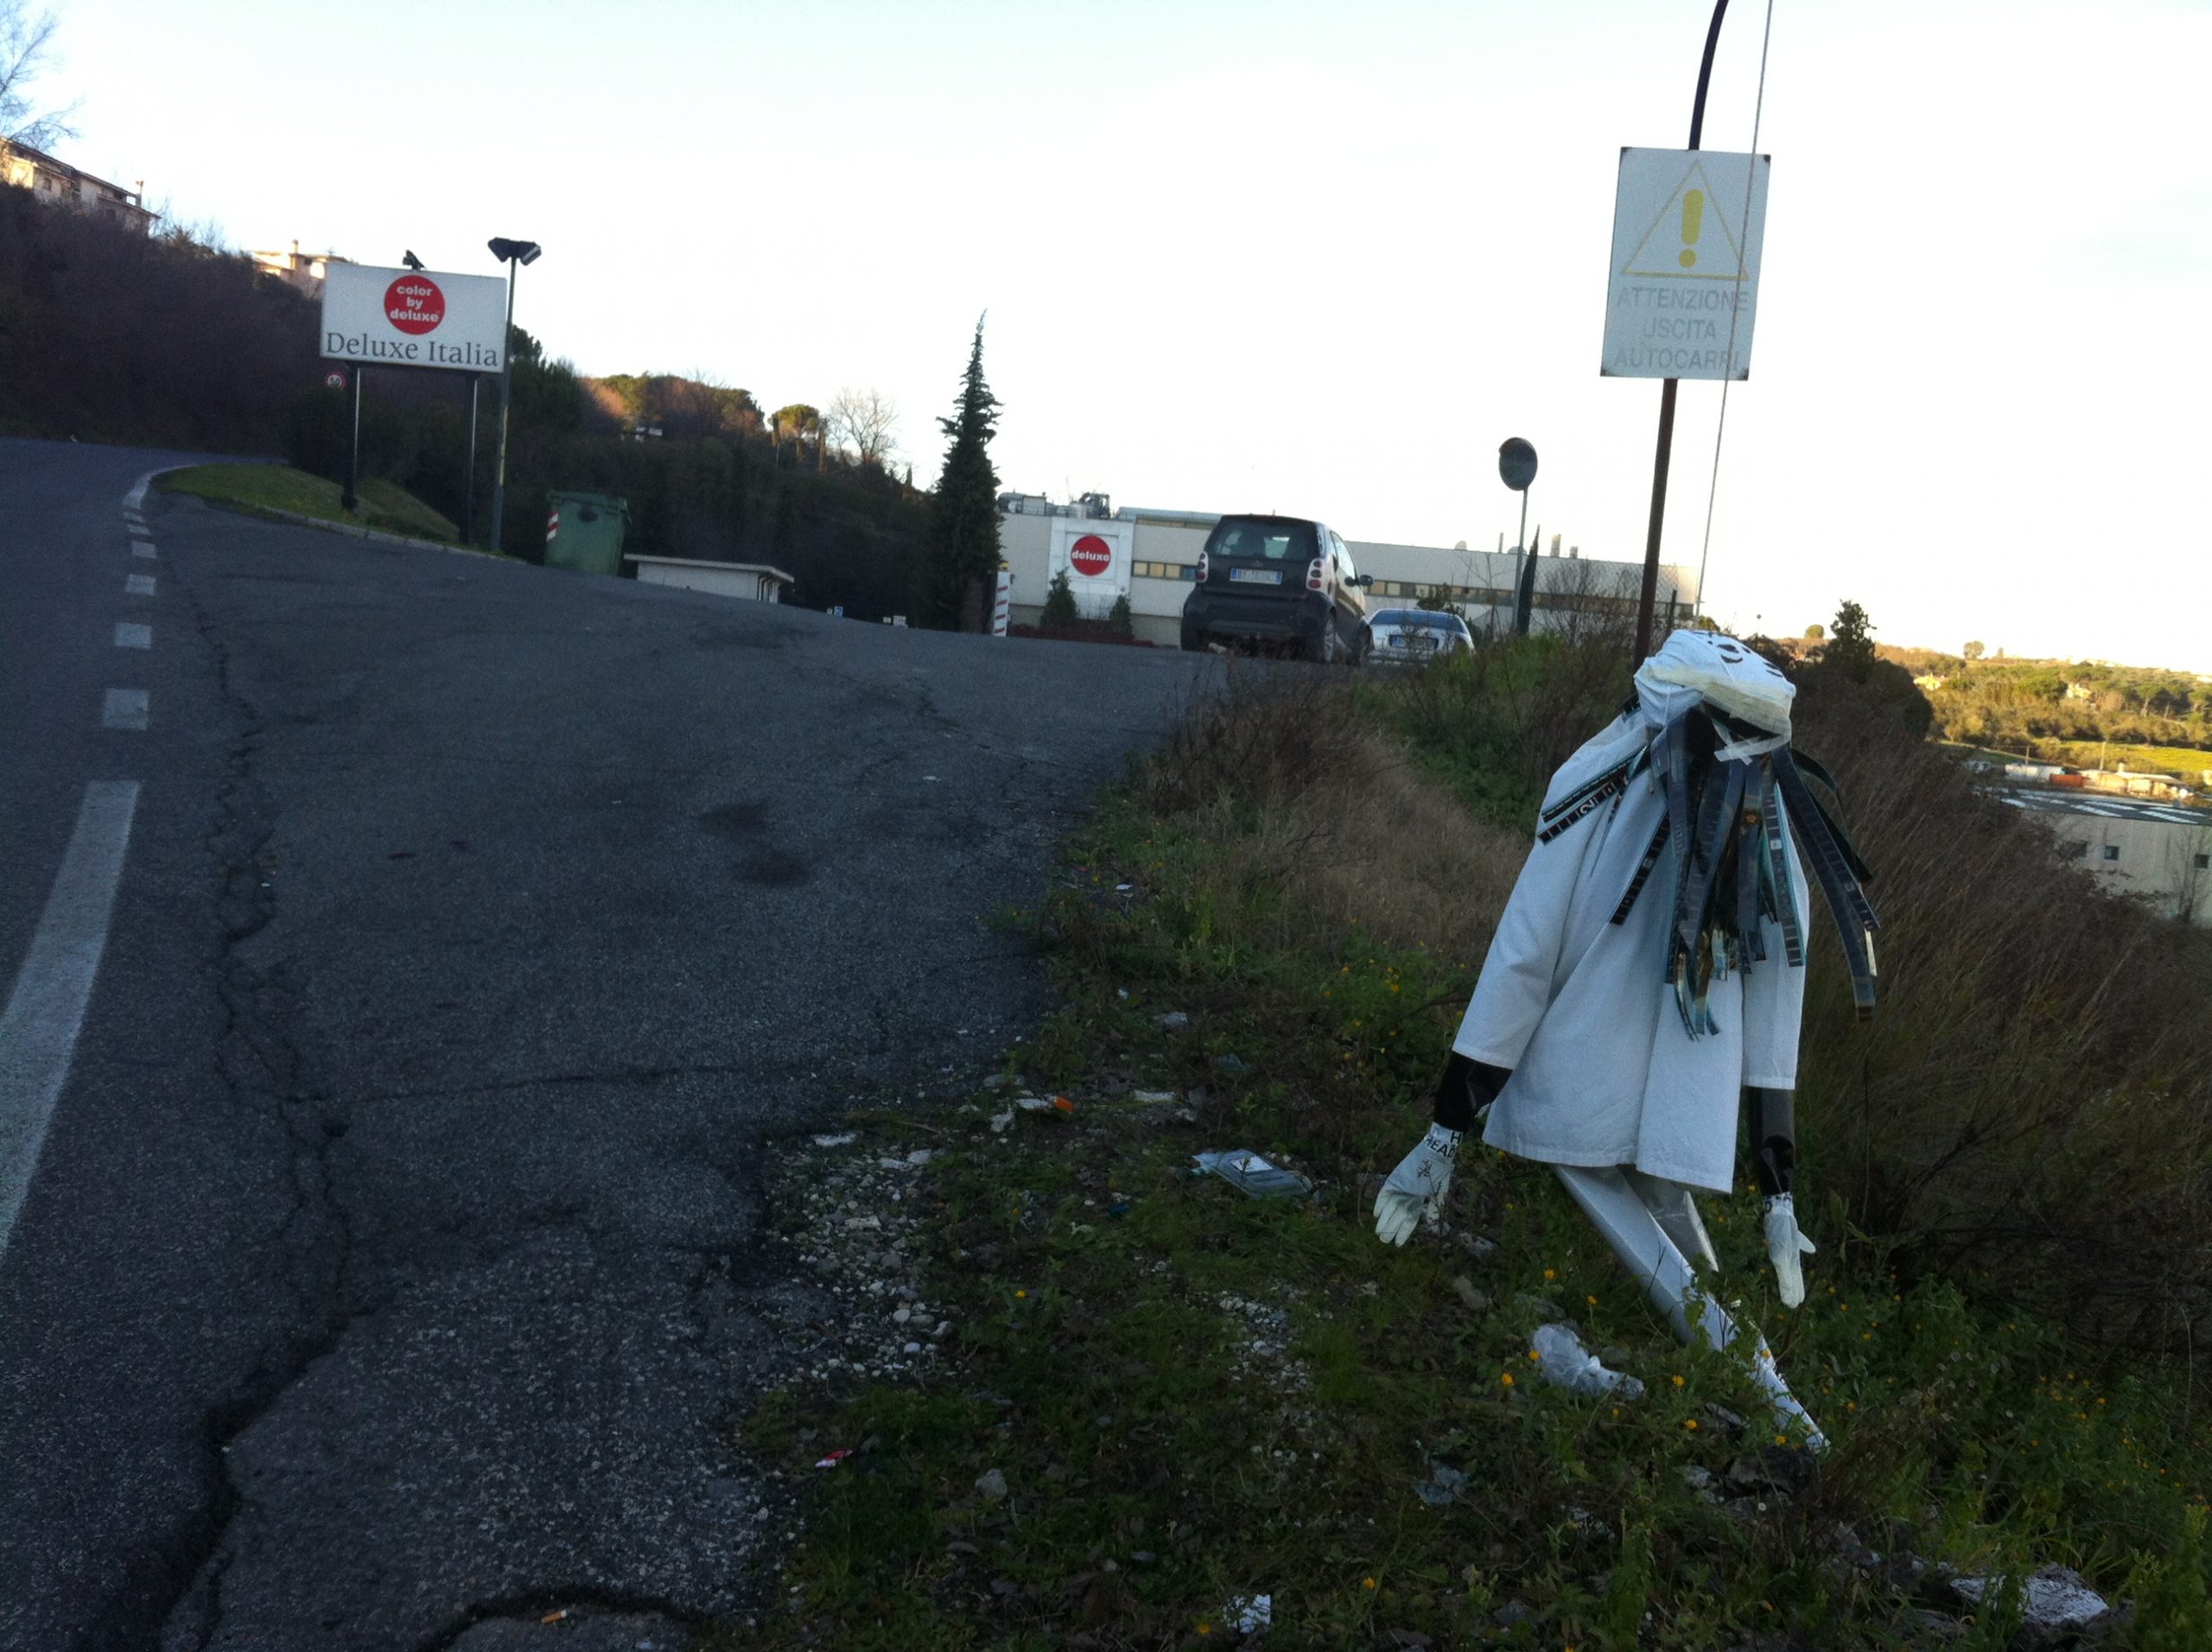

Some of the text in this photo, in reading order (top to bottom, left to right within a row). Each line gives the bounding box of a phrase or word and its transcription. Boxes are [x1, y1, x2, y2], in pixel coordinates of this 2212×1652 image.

[397, 284, 432, 297] color
[406, 296, 423, 310] by
[1617, 287, 1750, 311] ATTENZIONE
[390, 309, 439, 322] deluxe
[1642, 318, 1717, 340] USCITA
[326, 332, 499, 367] Deluxe Italia
[1071, 550, 1110, 562] deluxe
